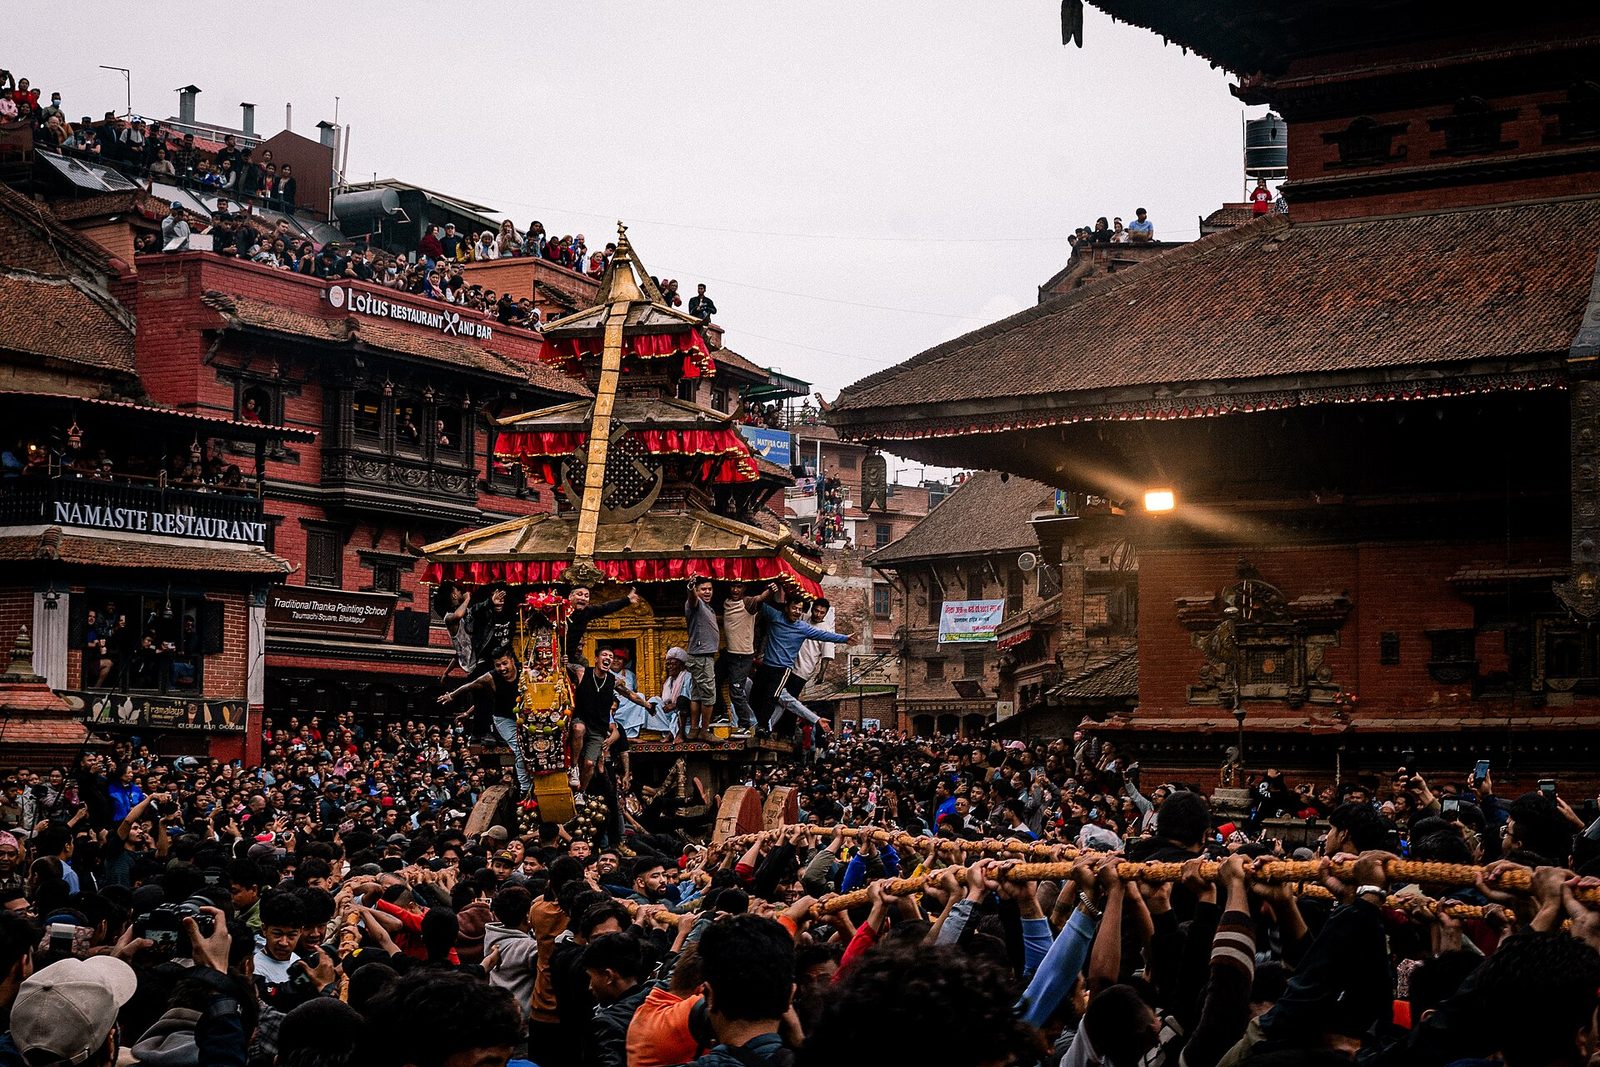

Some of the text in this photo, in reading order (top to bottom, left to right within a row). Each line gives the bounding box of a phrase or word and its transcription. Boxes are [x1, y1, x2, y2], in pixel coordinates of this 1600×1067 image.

[347, 288, 492, 340] Lotus RESTAURANT AND BAR
[776, 440, 788, 450] CAFE
[54, 501, 267, 543] NAMASTE RESTAURANT
[274, 597, 388, 616] Traditional Thanka Painting School
[338, 614, 365, 624] Bhaktapur
